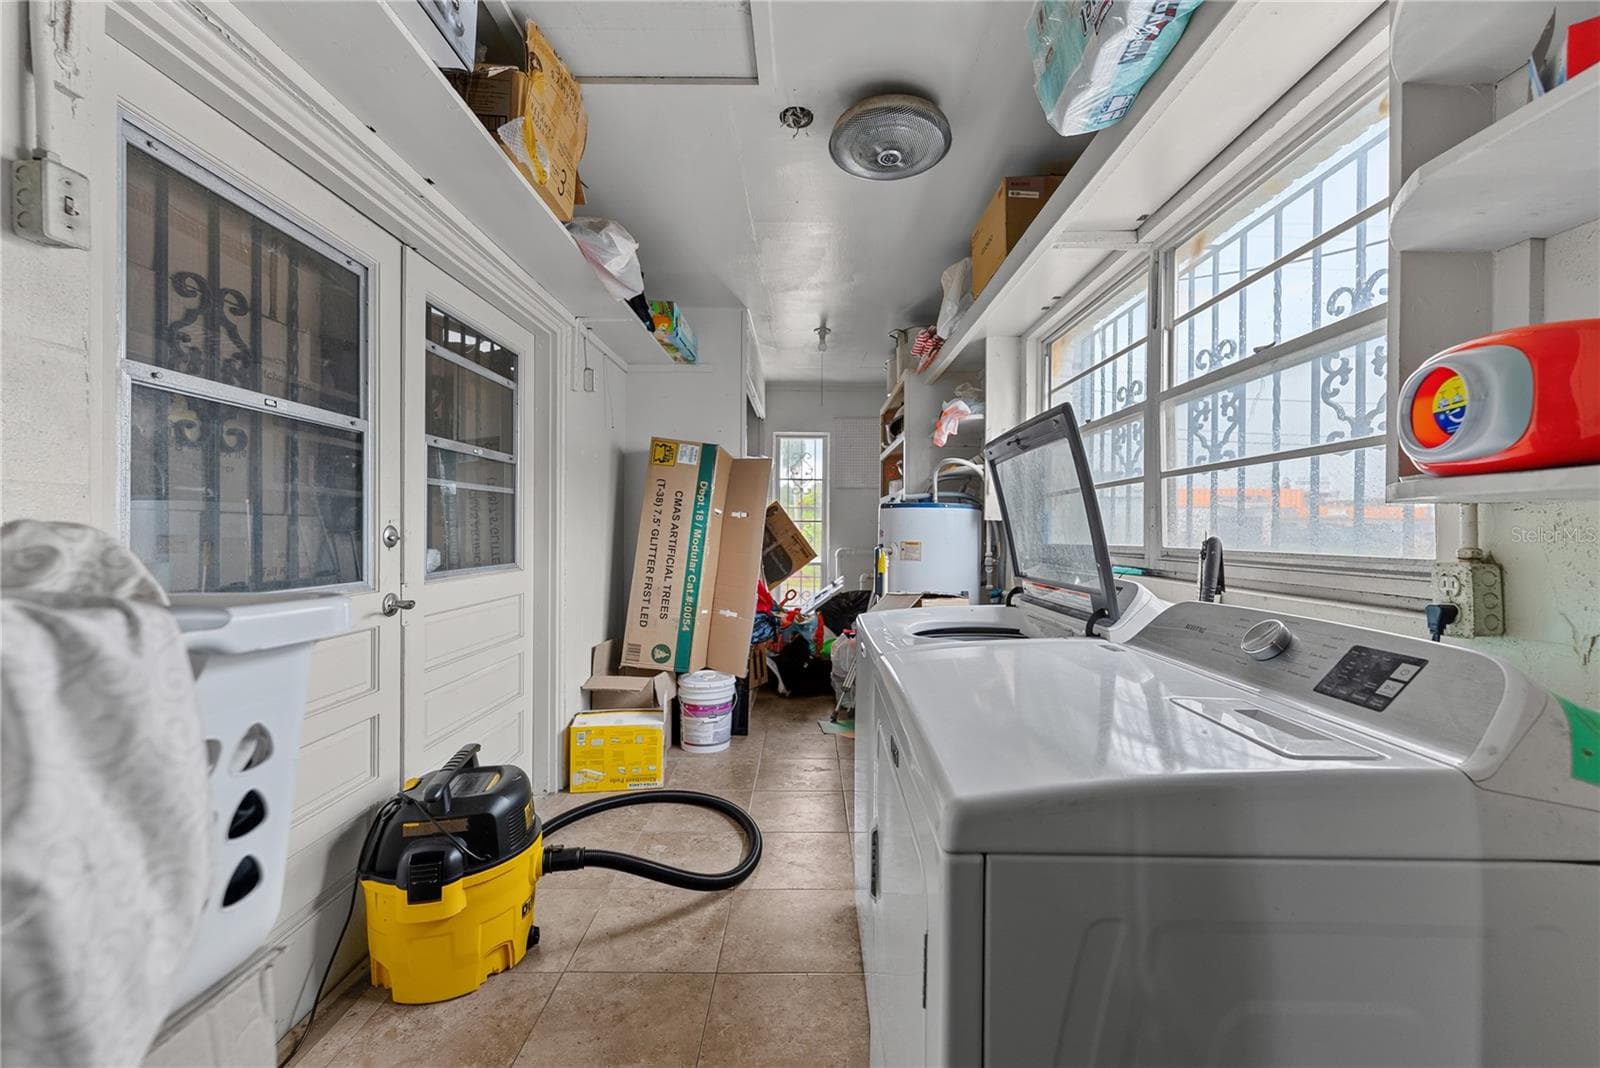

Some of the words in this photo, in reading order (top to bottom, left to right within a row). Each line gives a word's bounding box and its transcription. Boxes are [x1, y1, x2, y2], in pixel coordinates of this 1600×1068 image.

[653, 478, 667, 507] (T-38)
[672, 490, 684, 521] CMAS
[652, 509, 663, 527] 7.5'
[646, 528, 660, 575] GLITTER
[664, 523, 680, 582] ARTIFICIAL
[688, 529, 703, 573] Modular
[642, 576, 654, 604] FRST
[660, 584, 672, 620] TREES
[639, 606, 650, 628] LED
